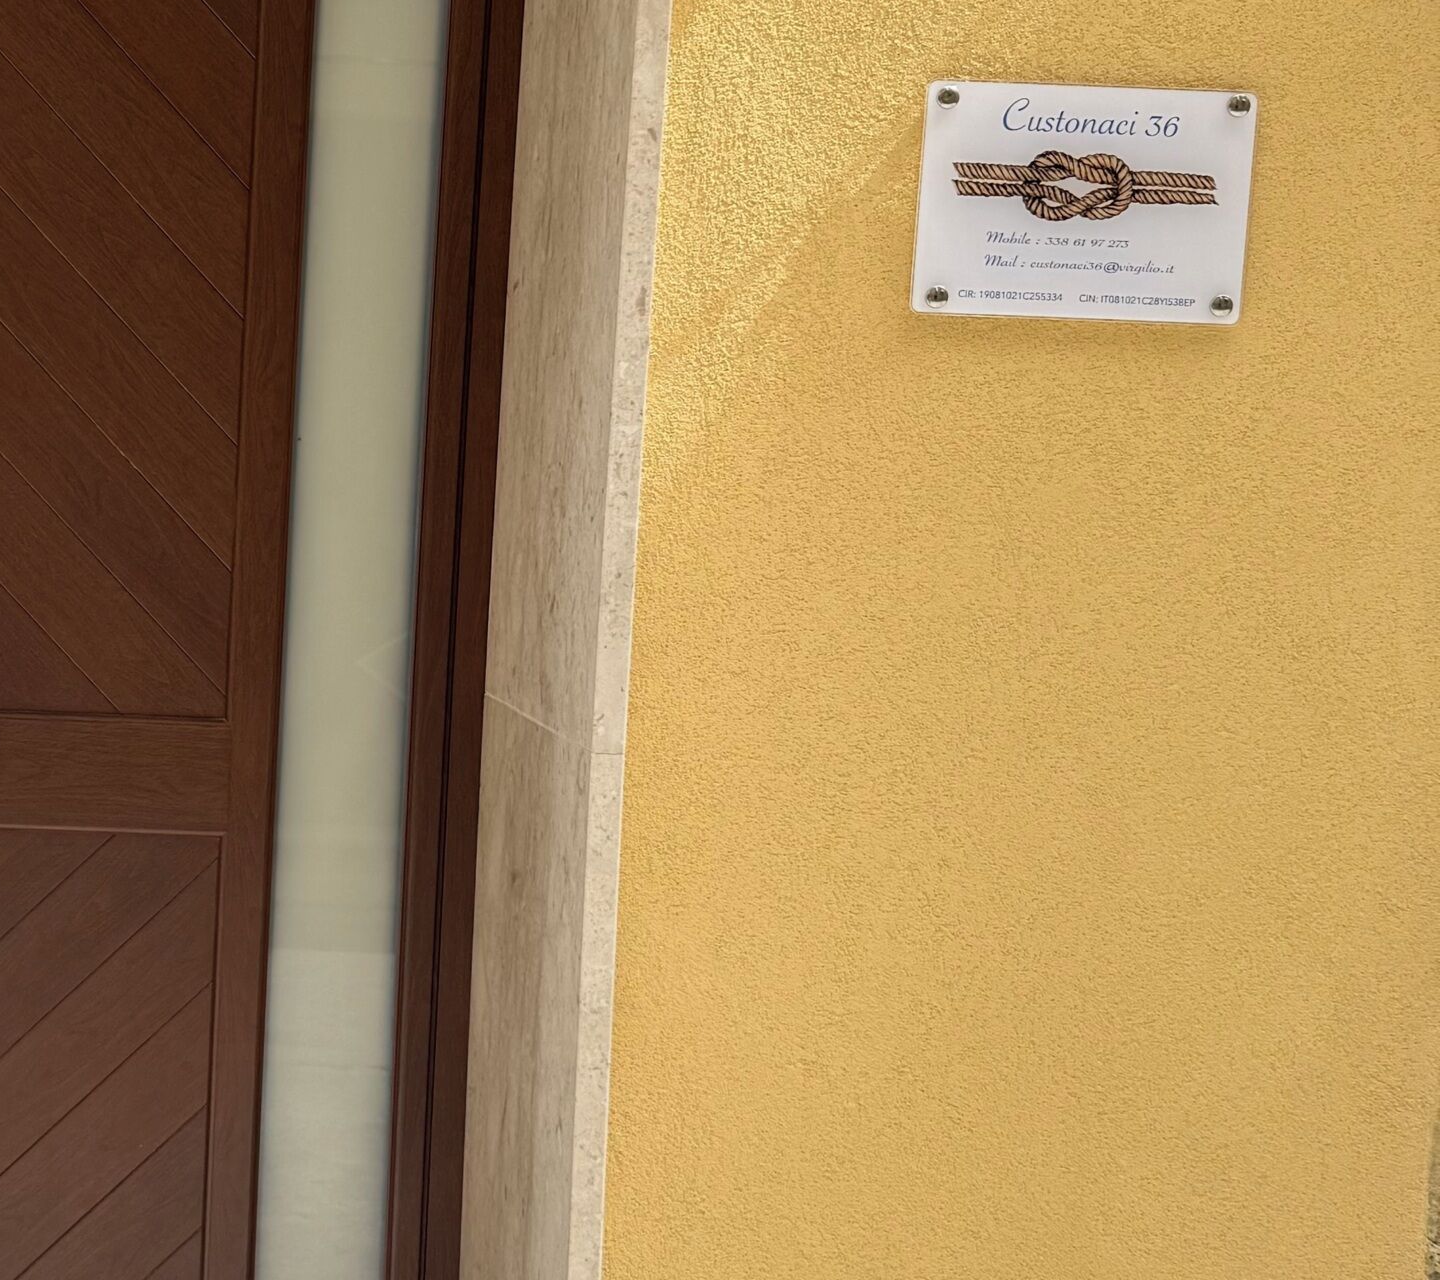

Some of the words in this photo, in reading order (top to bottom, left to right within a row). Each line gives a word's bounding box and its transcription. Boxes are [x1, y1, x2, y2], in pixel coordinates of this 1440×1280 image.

[1002, 97, 1139, 136] Custonaci
[1144, 115, 1180, 138] 36
[985, 231, 1031, 246] Mobile
[1044, 237, 1069, 247] 338
[1072, 238, 1086, 247] 61
[1090, 239, 1104, 248] 97
[1107, 239, 1129, 249] 273
[984, 254, 1019, 268] Mail
[1030, 260, 1175, 275] custonaci36@virgilio.it
[958, 289, 976, 299] CIR:
[1079, 294, 1099, 304] CIN:
